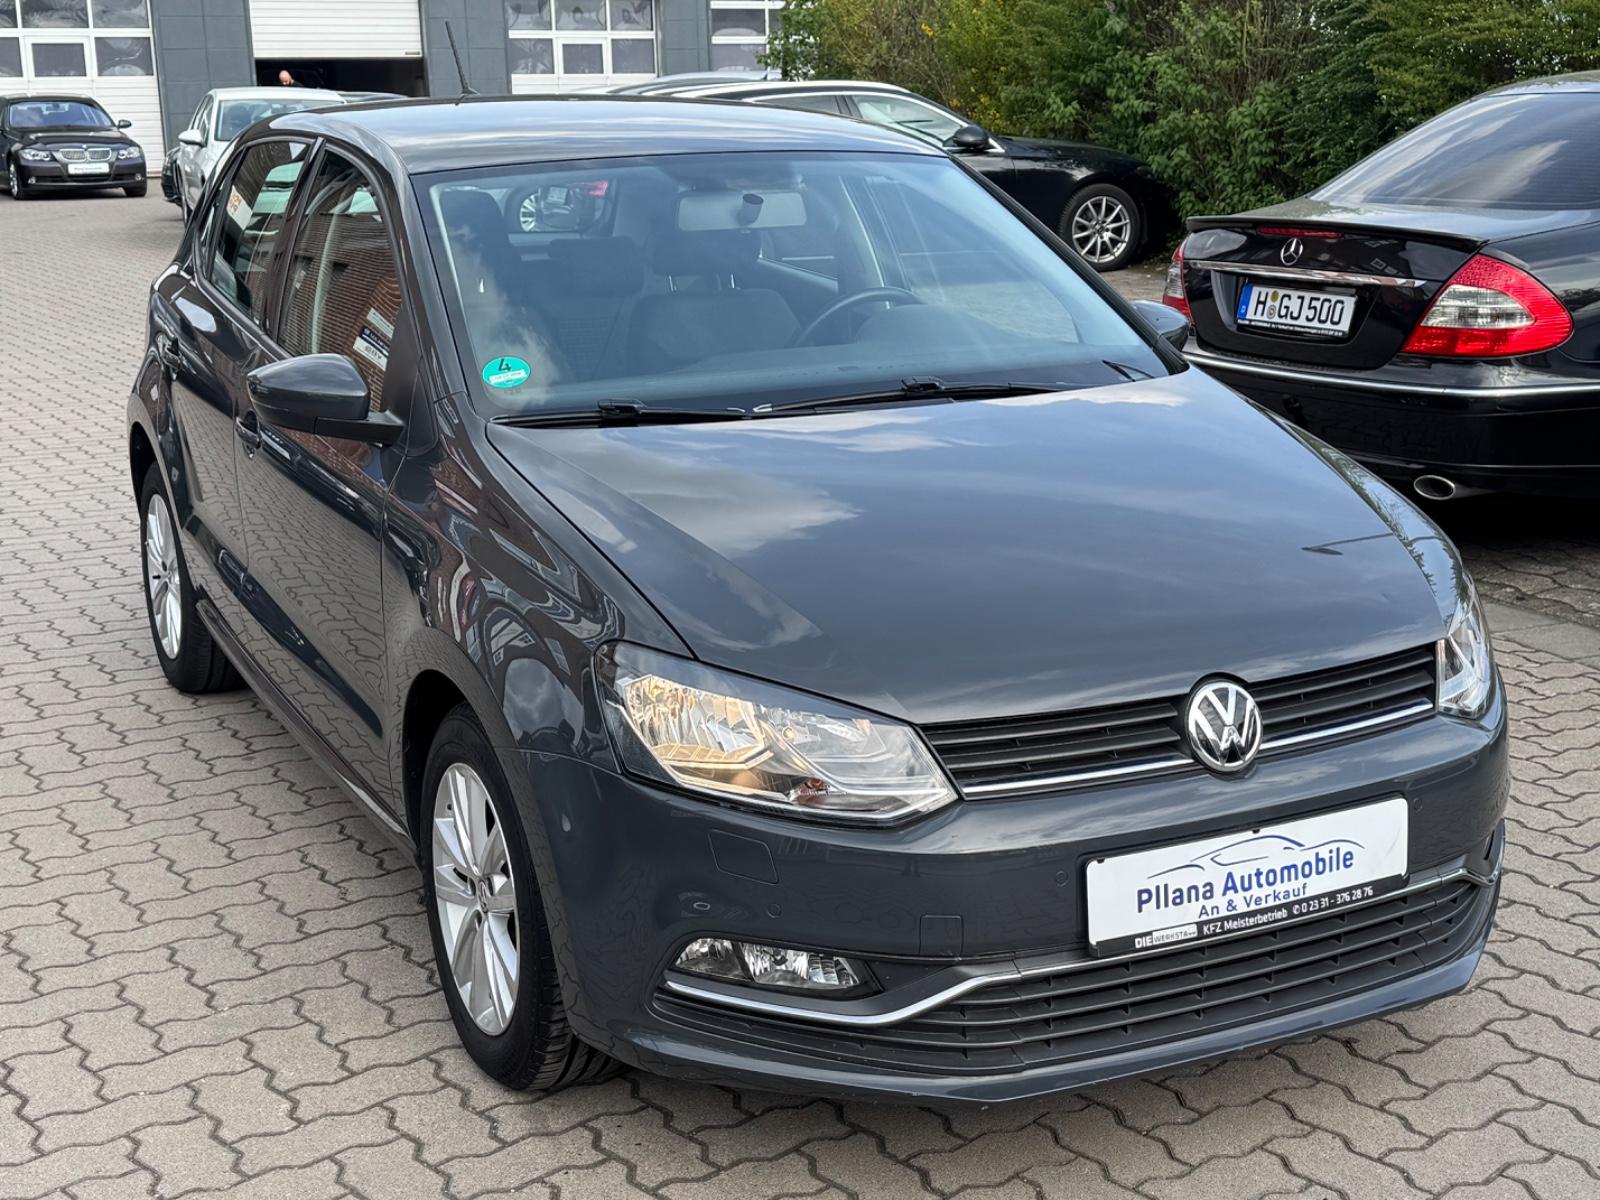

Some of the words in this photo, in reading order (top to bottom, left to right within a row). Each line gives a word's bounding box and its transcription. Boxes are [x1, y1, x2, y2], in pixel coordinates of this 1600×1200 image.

[1254, 290, 1269, 318] H
[1305, 296, 1345, 326] 500
[498, 358, 512, 372] 4
[1137, 881, 1214, 913] Pllana
[1221, 848, 1354, 896] Automobile
[1198, 904, 1220, 919] An
[1226, 898, 1238, 912] &
[1243, 882, 1307, 908] Verkauf
[1202, 922, 1223, 935] KFZ
[1223, 907, 1288, 931] Meisterbetrieb
[1308, 900, 1319, 912] 23
[1335, 891, 1351, 904] 376
